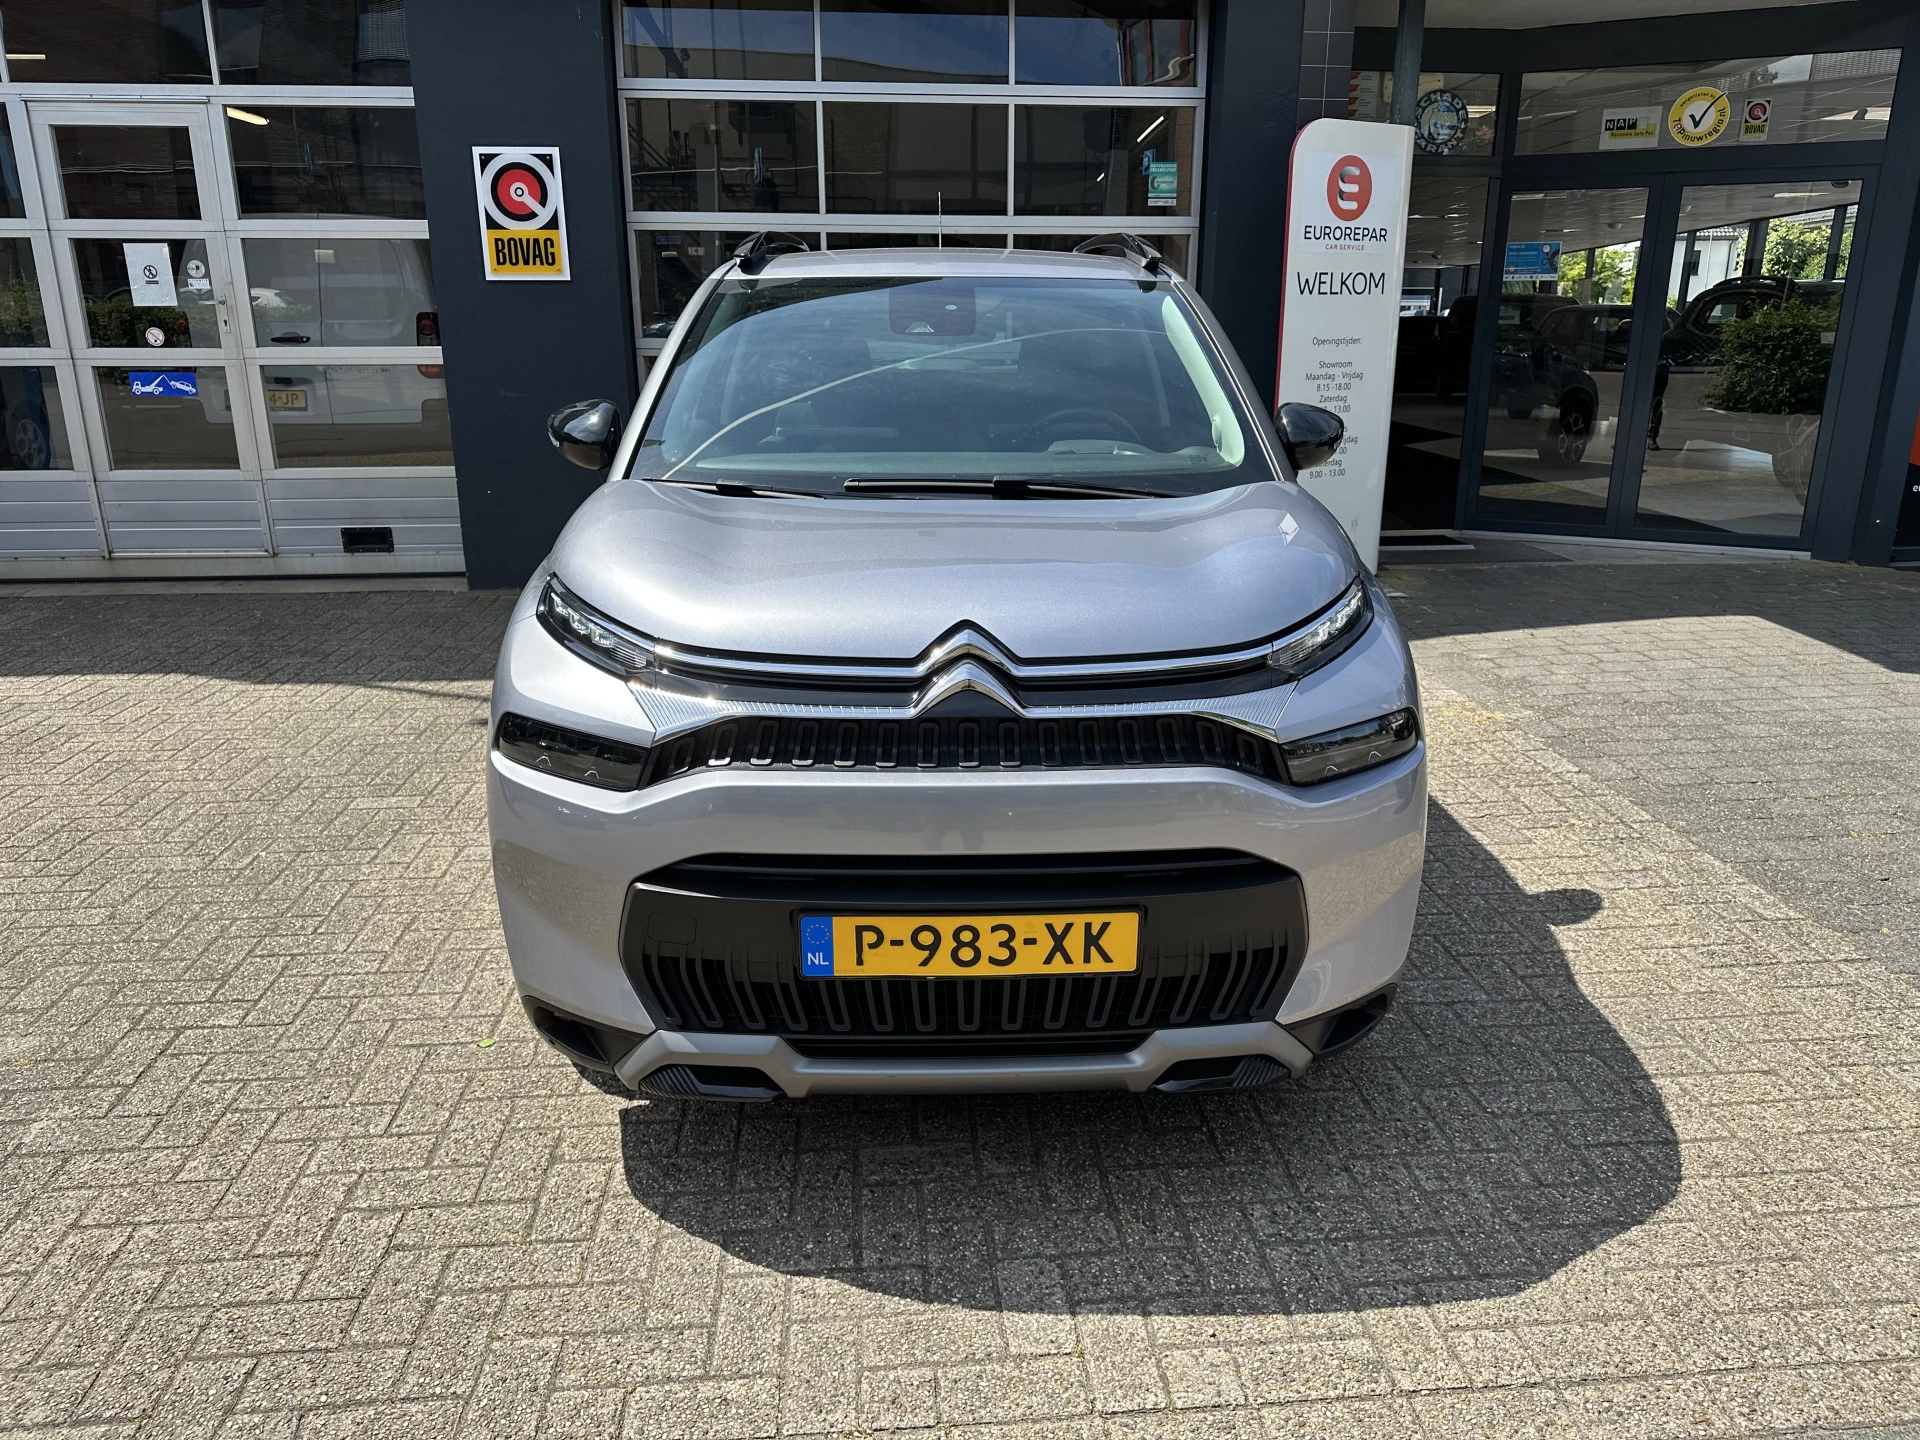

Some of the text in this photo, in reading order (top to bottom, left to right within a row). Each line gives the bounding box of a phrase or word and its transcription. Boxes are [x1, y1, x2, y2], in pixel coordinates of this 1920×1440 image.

[1744, 124, 1765, 135] BOVAG
[1304, 225, 1387, 242] EUROREPAR
[494, 237, 556, 267] BOVAG
[1297, 271, 1385, 295] WELKOM
[1318, 360, 1353, 369] Showroom
[1305, 372, 1336, 382] Maandag
[1341, 371, 1364, 380] Vrijdag
[1316, 383, 1330, 392] 8.15
[1319, 394, 1348, 404] Zaterdag
[1329, 468, 1346, 477] 13.00
[854, 921, 1114, 968] P-983-XK
[807, 952, 829, 966] NL
